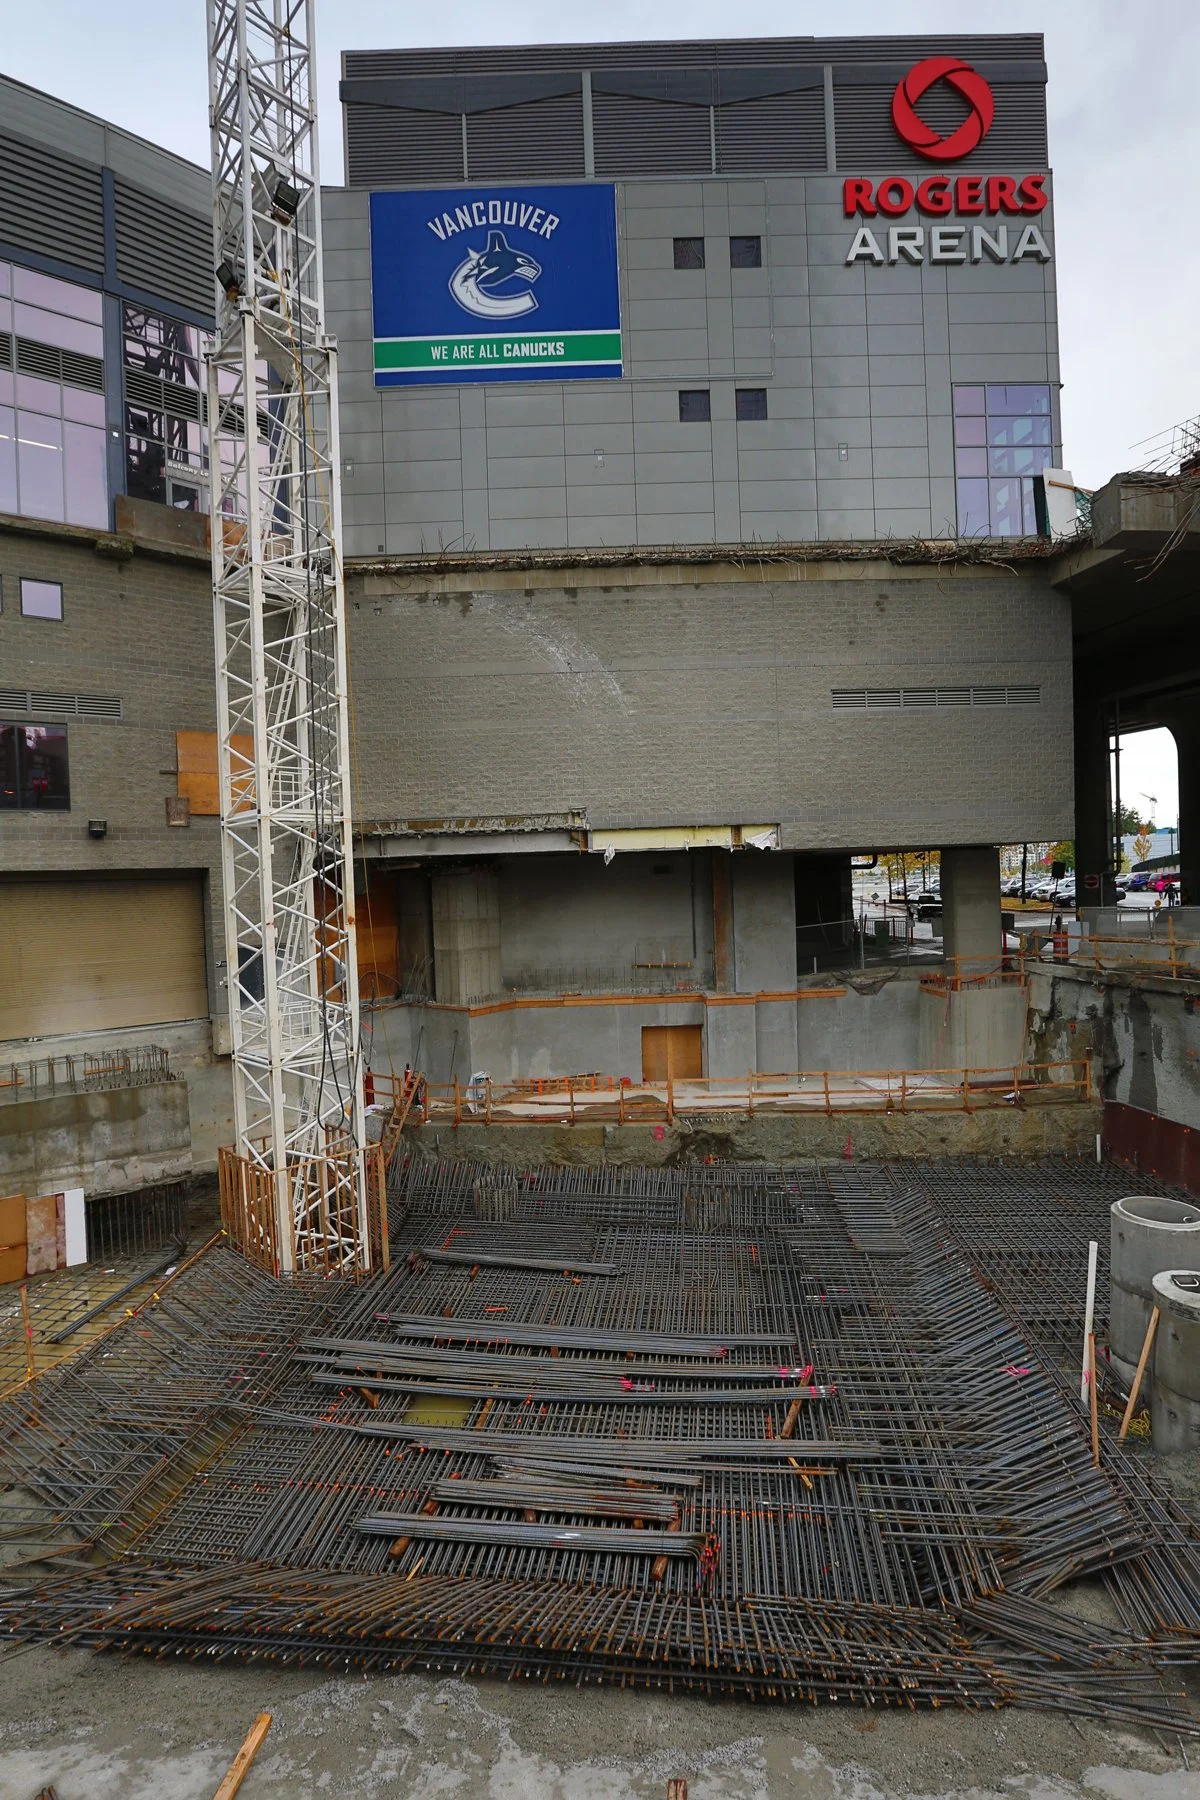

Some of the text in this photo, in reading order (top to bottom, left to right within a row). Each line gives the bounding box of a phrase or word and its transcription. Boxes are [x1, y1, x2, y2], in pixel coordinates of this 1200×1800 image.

[843, 175, 1048, 217] ROGERS
[427, 200, 560, 240] VANCOUVER
[846, 224, 1052, 265] ARENA
[431, 341, 565, 360] WE ARE ALL CANUCKS
[167, 460, 198, 475] Balcony
